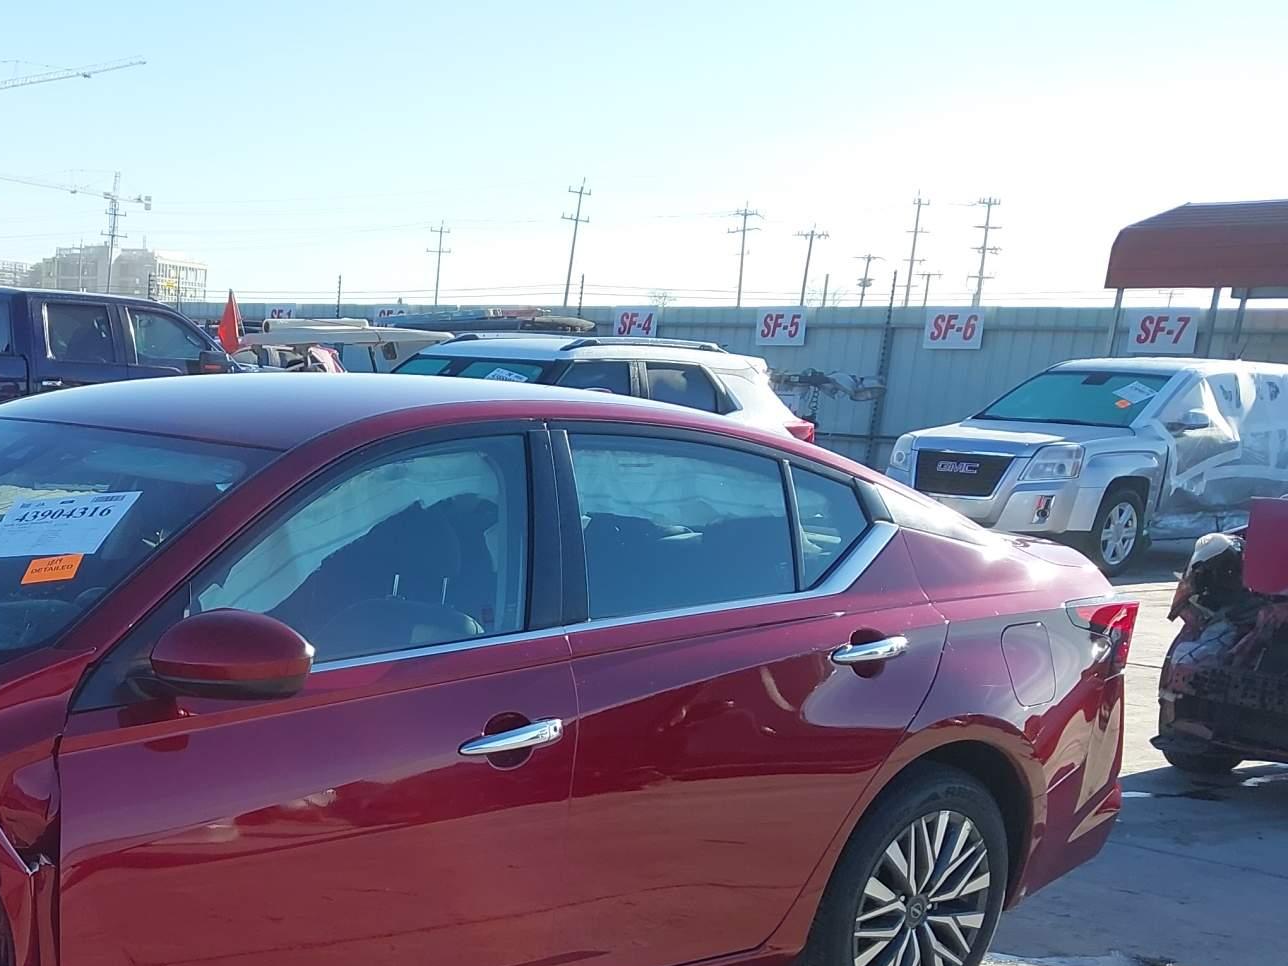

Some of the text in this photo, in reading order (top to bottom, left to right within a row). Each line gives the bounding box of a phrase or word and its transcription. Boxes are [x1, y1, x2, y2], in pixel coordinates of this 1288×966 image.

[617, 312, 654, 336] SF-4
[760, 313, 802, 338] SF-5
[930, 314, 978, 341] SF-6
[1136, 315, 1191, 345] SF-7
[936, 460, 980, 474] GMC
[15, 505, 114, 523] 43904316
